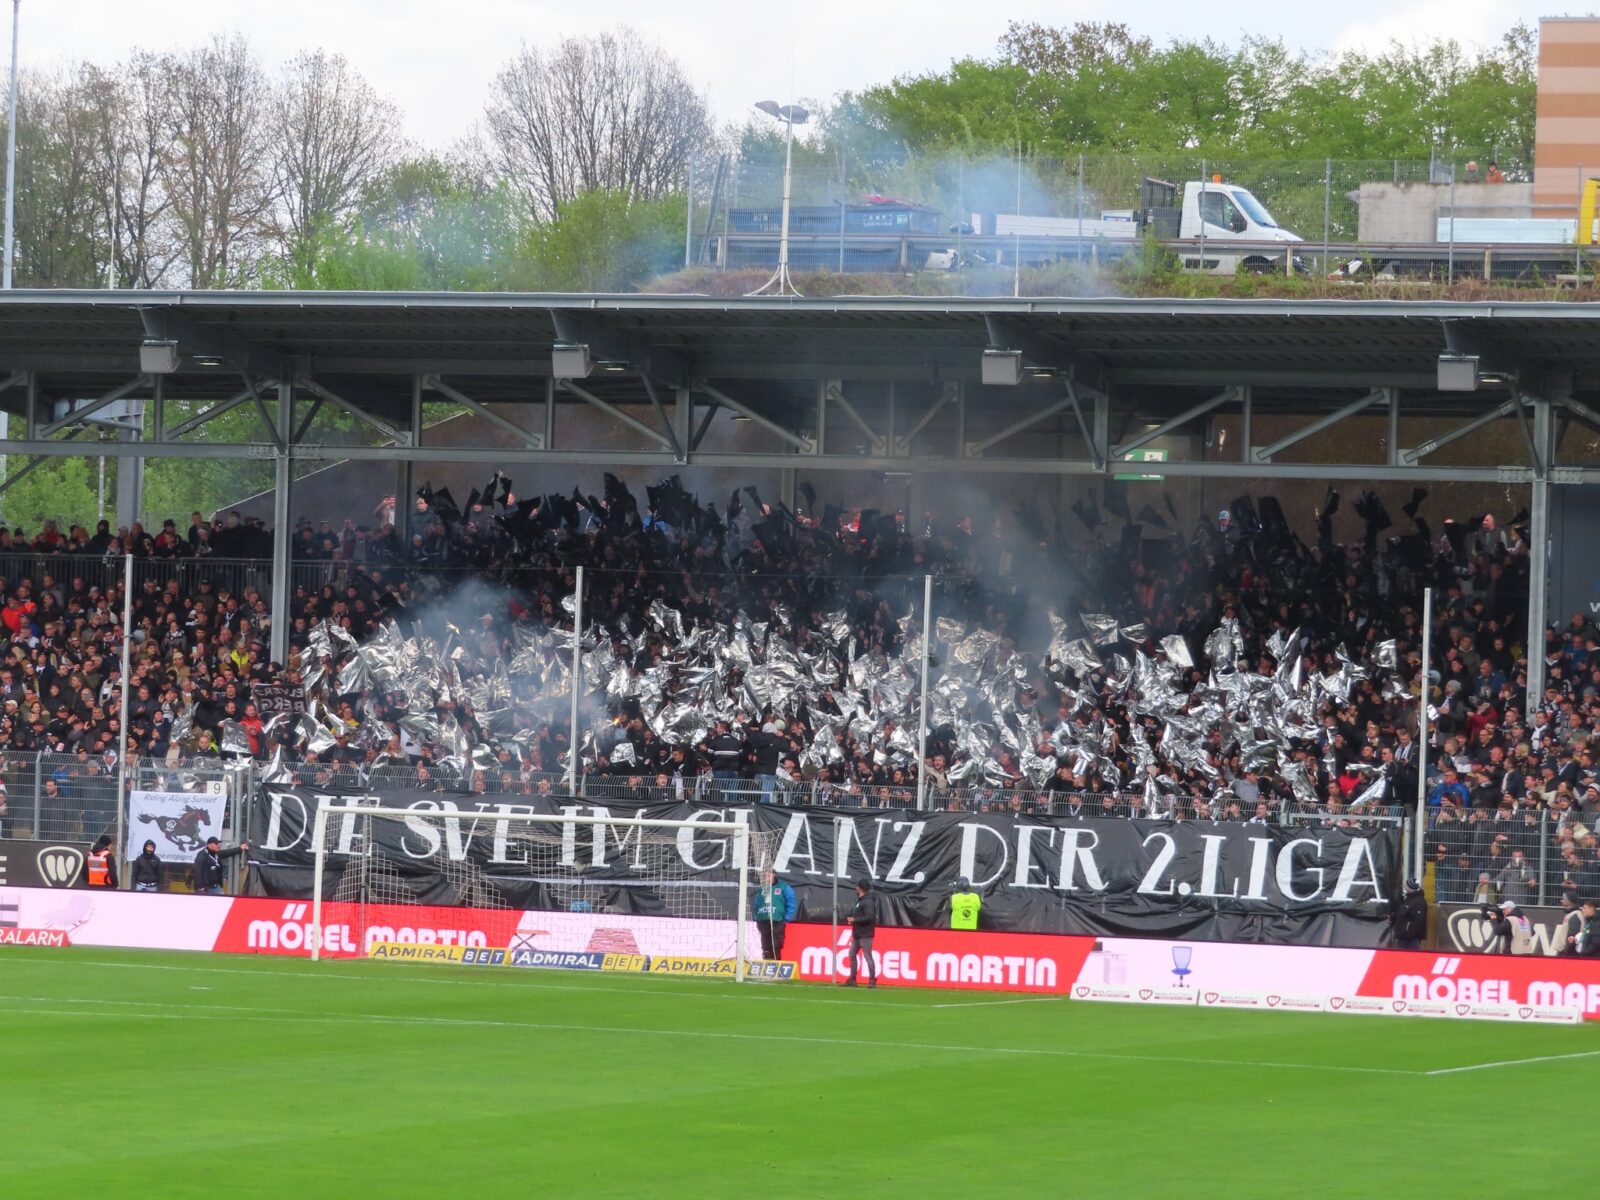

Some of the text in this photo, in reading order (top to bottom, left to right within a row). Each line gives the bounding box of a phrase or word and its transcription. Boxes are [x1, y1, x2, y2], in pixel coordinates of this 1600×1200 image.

[214, 783, 221, 794] 9
[260, 792, 1389, 903] DIE SVE IM GLANZ DER 2.LIGA
[248, 903, 356, 953] MÖBEL
[374, 944, 505, 963] ADMIRAL BET
[516, 951, 643, 969] ADMIRAL BET
[751, 965, 792, 977] BET
[926, 952, 1057, 987] MARTIN
[1393, 957, 1517, 1005] MÖBEL
